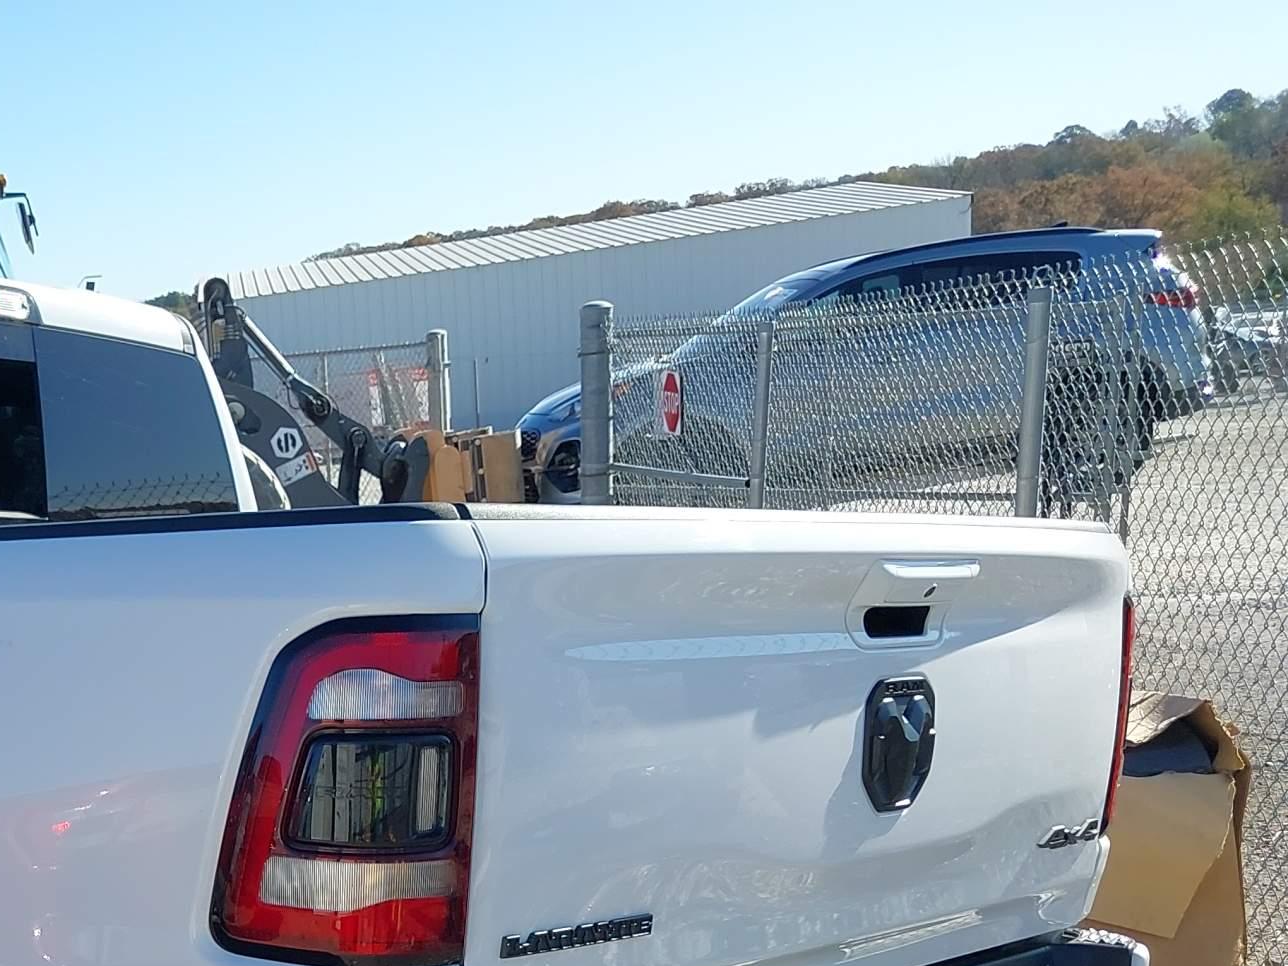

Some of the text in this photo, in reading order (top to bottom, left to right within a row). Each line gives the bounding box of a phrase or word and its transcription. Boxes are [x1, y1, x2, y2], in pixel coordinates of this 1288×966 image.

[663, 391, 680, 414] STOP
[884, 681, 925, 695] RAM
[499, 913, 653, 959] LARAMIE
